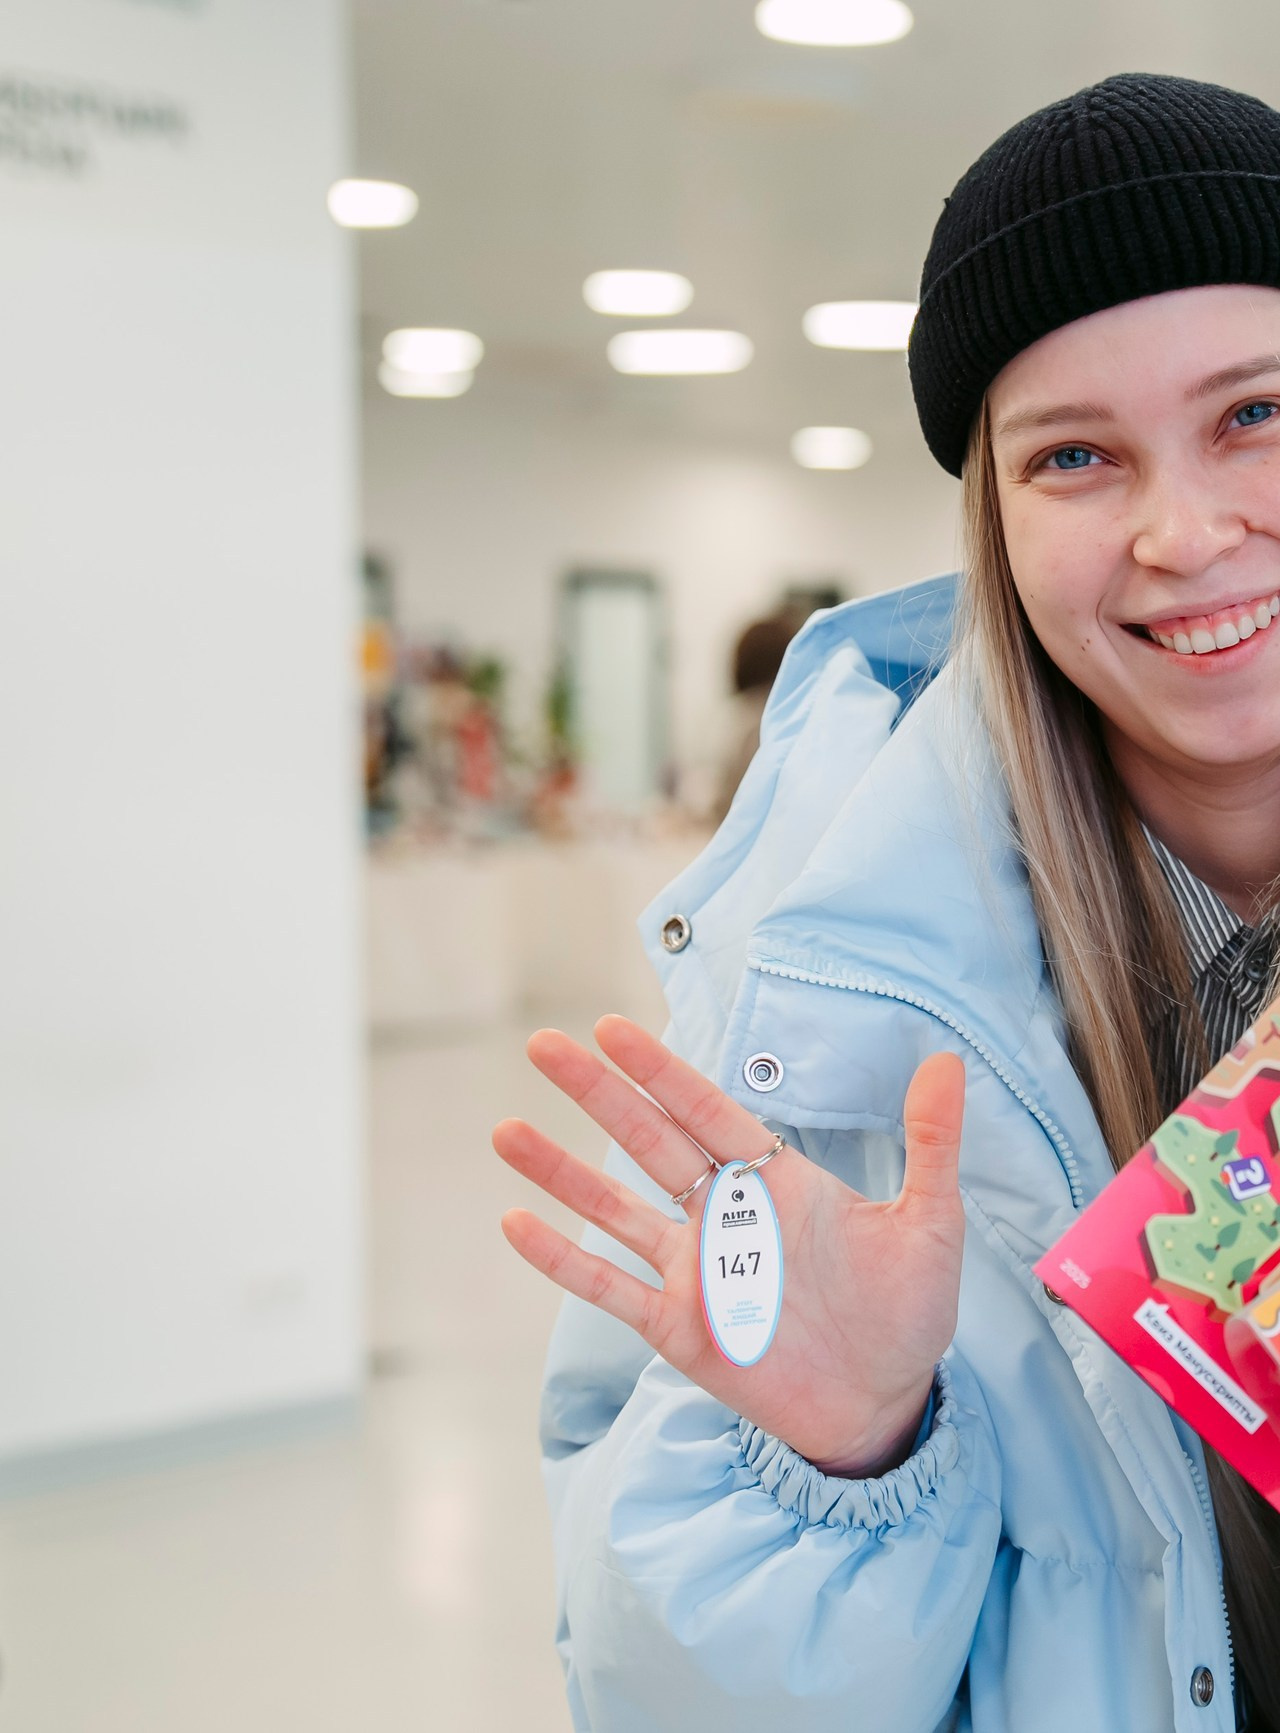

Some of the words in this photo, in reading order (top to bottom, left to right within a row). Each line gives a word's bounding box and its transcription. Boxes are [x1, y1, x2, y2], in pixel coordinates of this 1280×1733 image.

[722, 1209, 757, 1221] ЛИГА
[717, 1251, 762, 1280] 147
[1144, 1309, 1174, 1344] Квиз
[1175, 1340, 1257, 1425] Манускрипты
